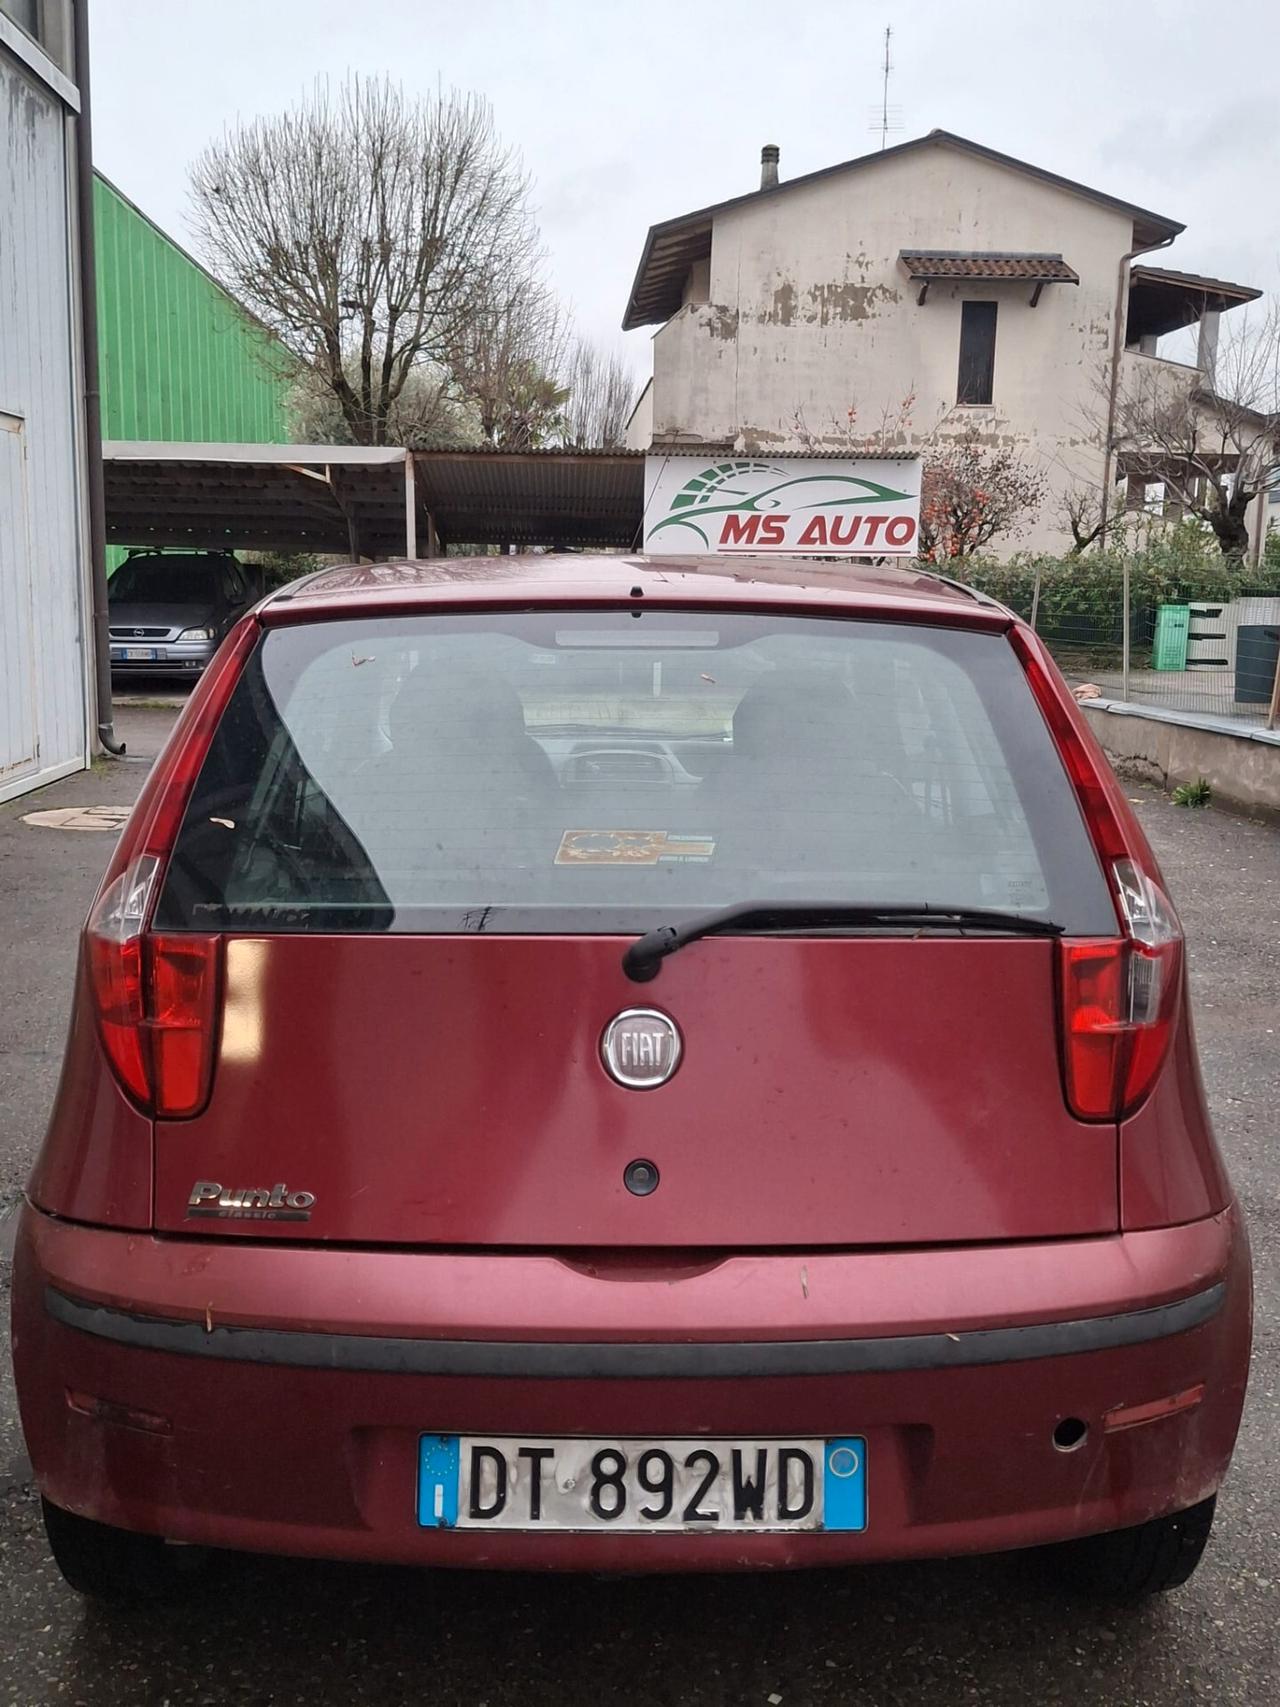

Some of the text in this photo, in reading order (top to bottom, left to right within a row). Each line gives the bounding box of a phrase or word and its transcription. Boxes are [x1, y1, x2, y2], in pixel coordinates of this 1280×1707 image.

[719, 514, 916, 546] MS AUTO
[621, 1032, 664, 1066] FIAT
[188, 1181, 316, 1208] Punto
